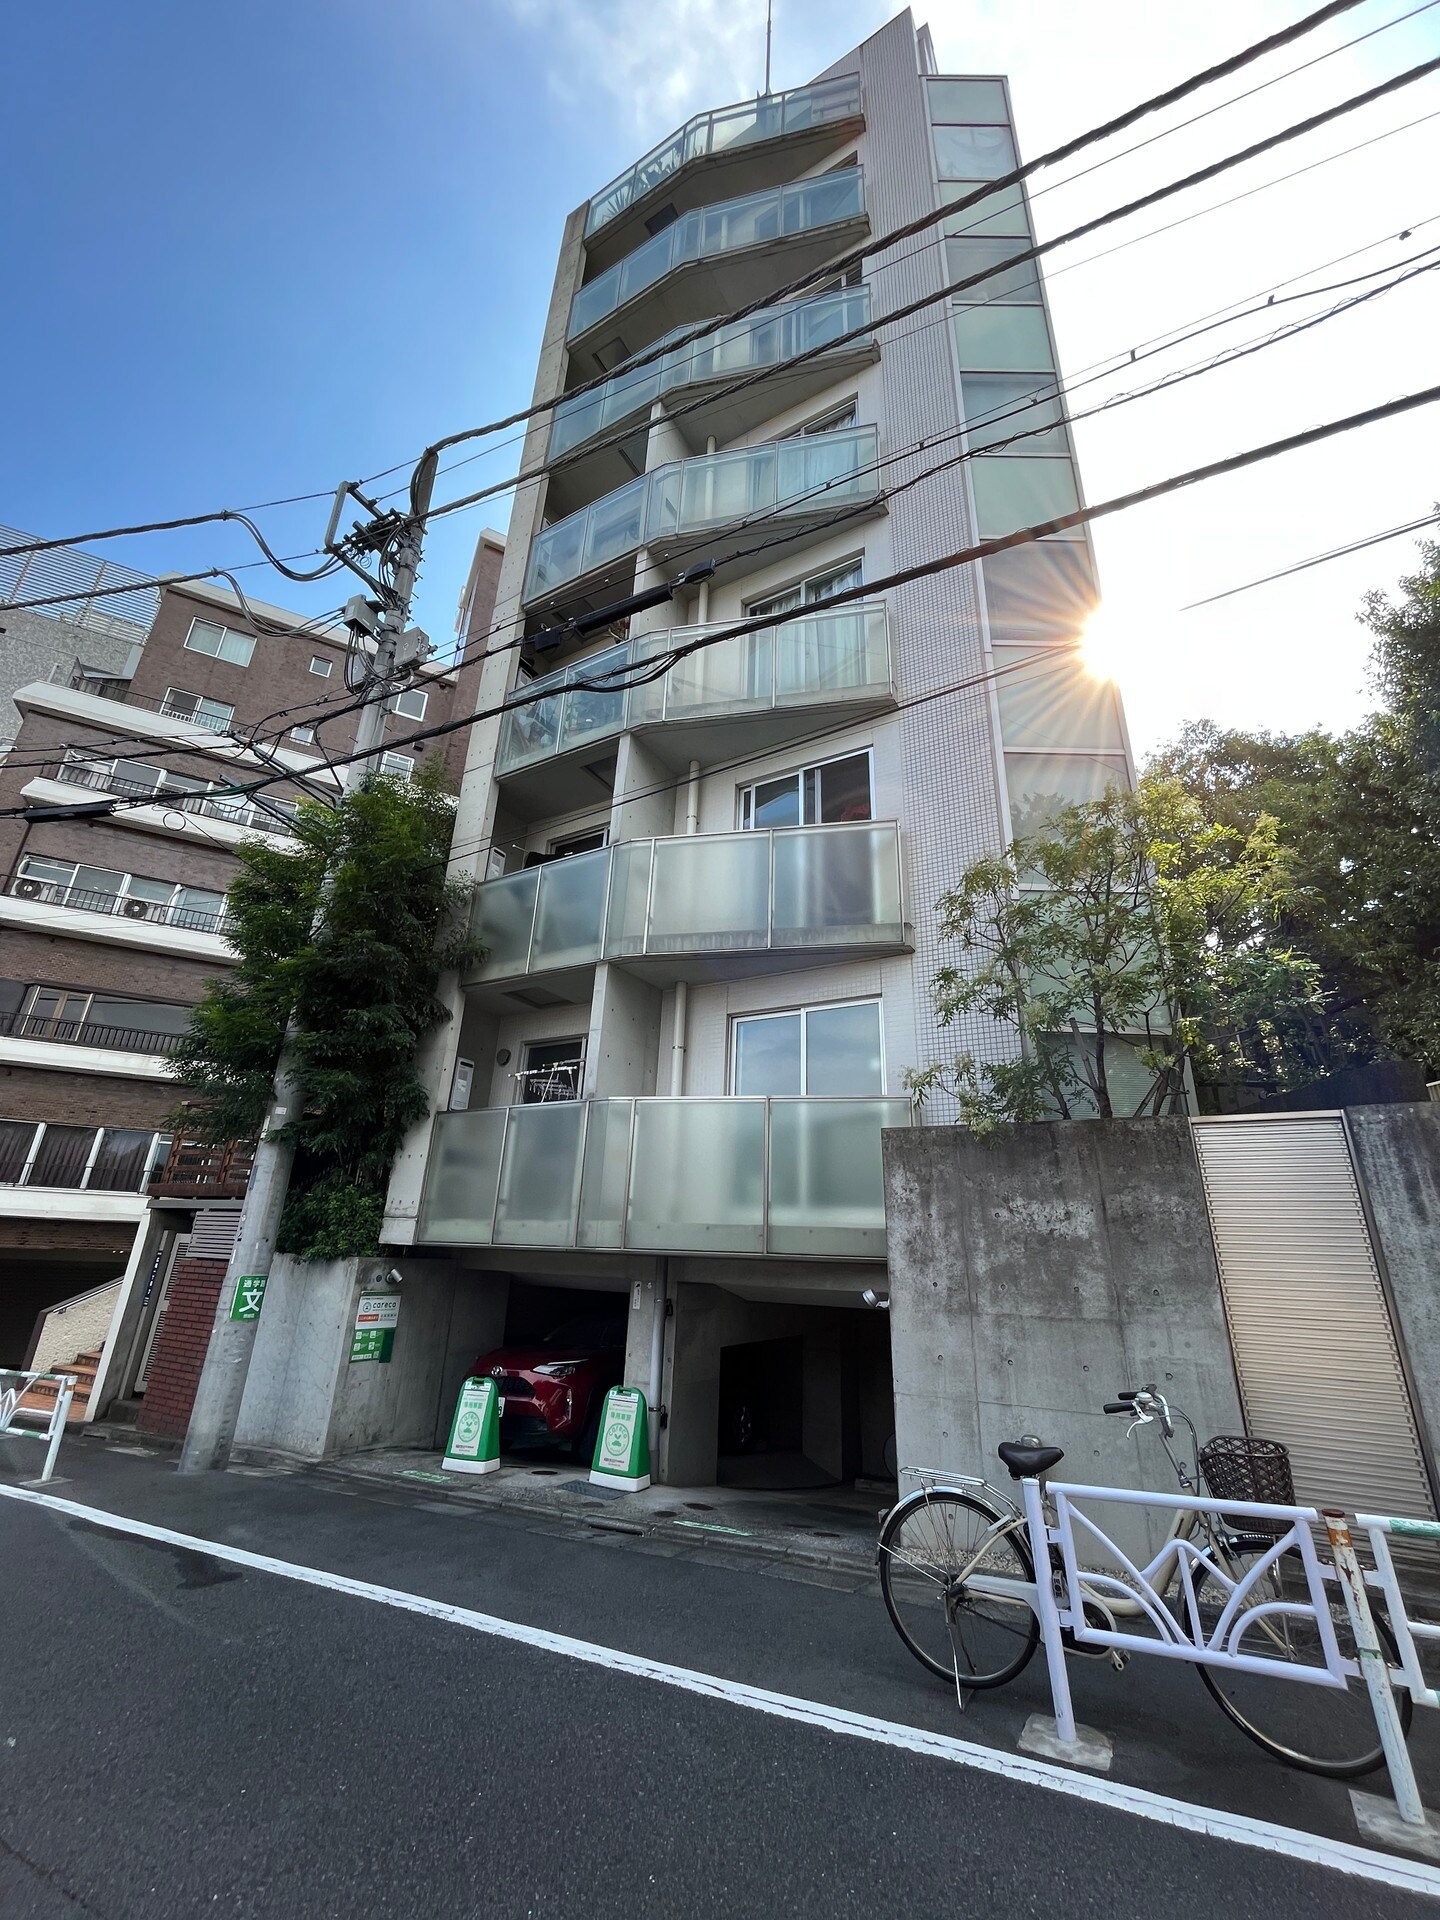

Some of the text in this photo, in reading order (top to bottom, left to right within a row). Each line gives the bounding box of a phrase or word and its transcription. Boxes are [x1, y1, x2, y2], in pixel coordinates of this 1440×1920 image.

[238, 1288, 263, 1313] 文
[372, 1301, 397, 1309] careco
[461, 1413, 479, 1426] careco
[608, 1425, 629, 1439] careco
